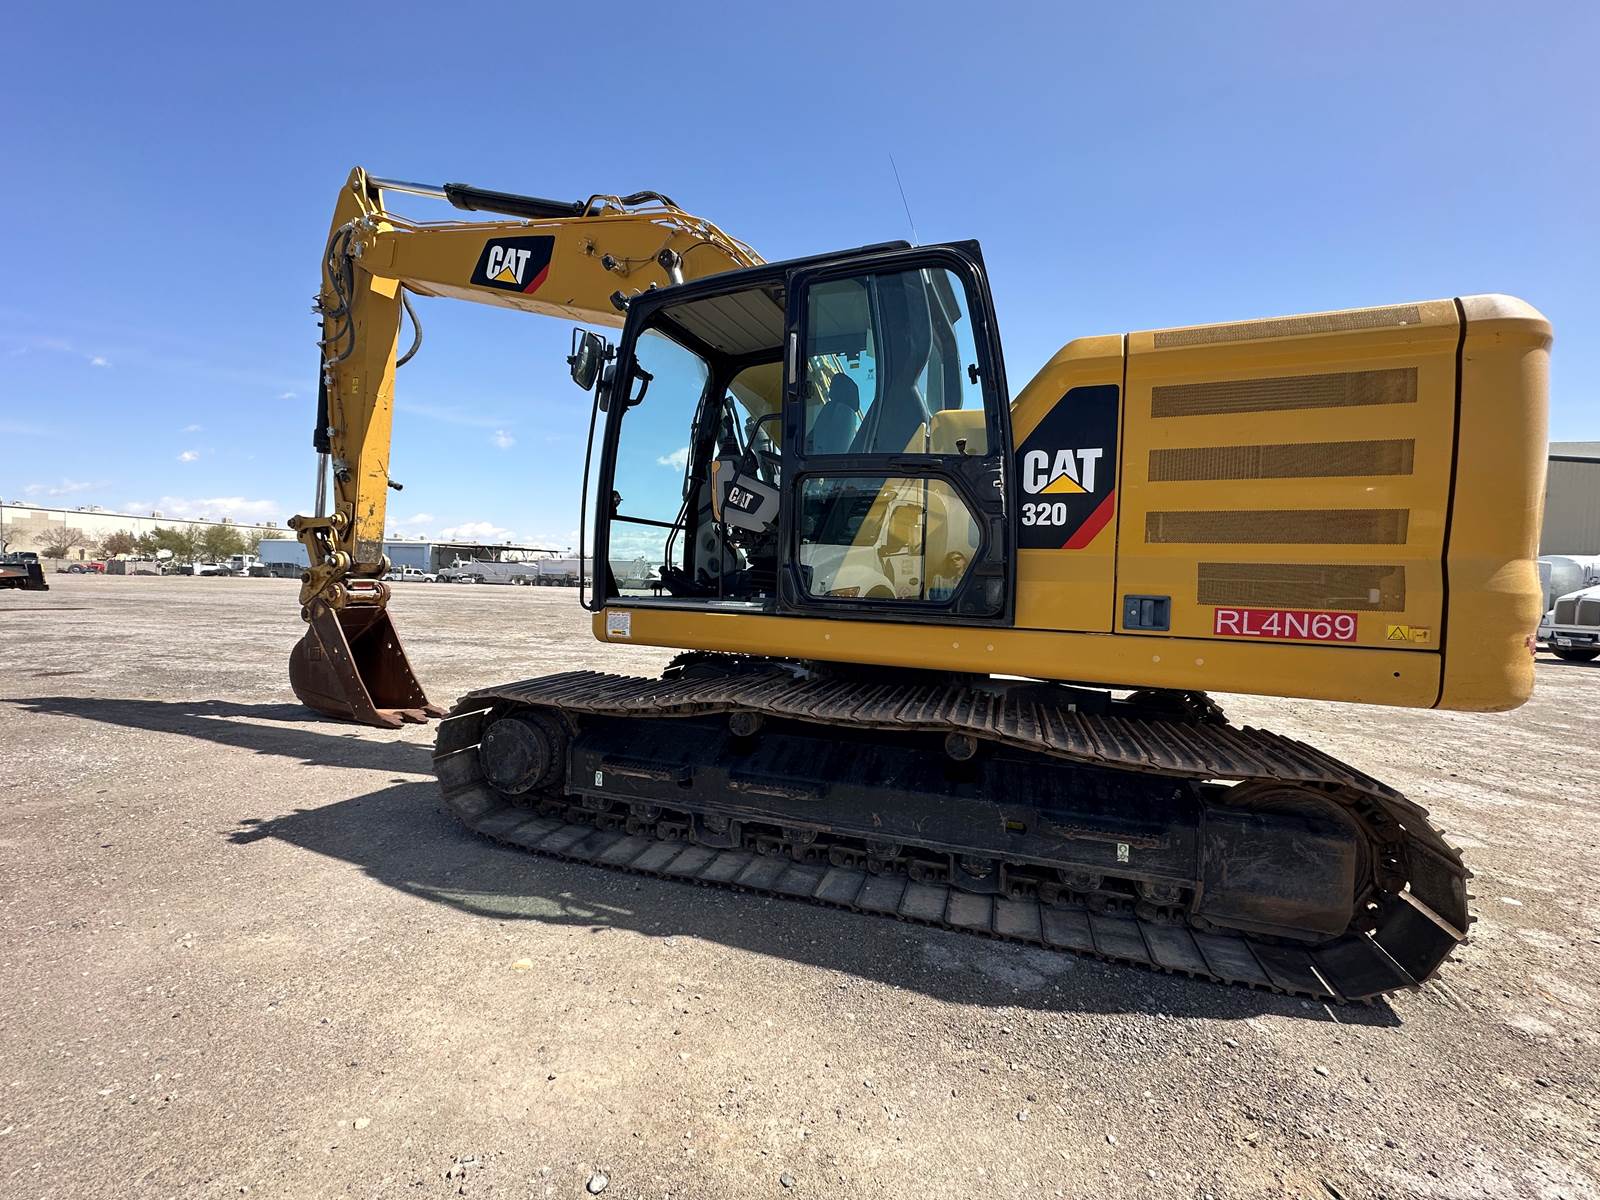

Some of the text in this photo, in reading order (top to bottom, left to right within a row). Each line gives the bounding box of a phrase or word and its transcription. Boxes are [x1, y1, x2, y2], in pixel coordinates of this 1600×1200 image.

[486, 245, 531, 284] CAT
[1023, 448, 1103, 494] CAT
[728, 487, 754, 509] CAT
[1021, 502, 1067, 526] 320
[1216, 610, 1355, 640] RL4N69
